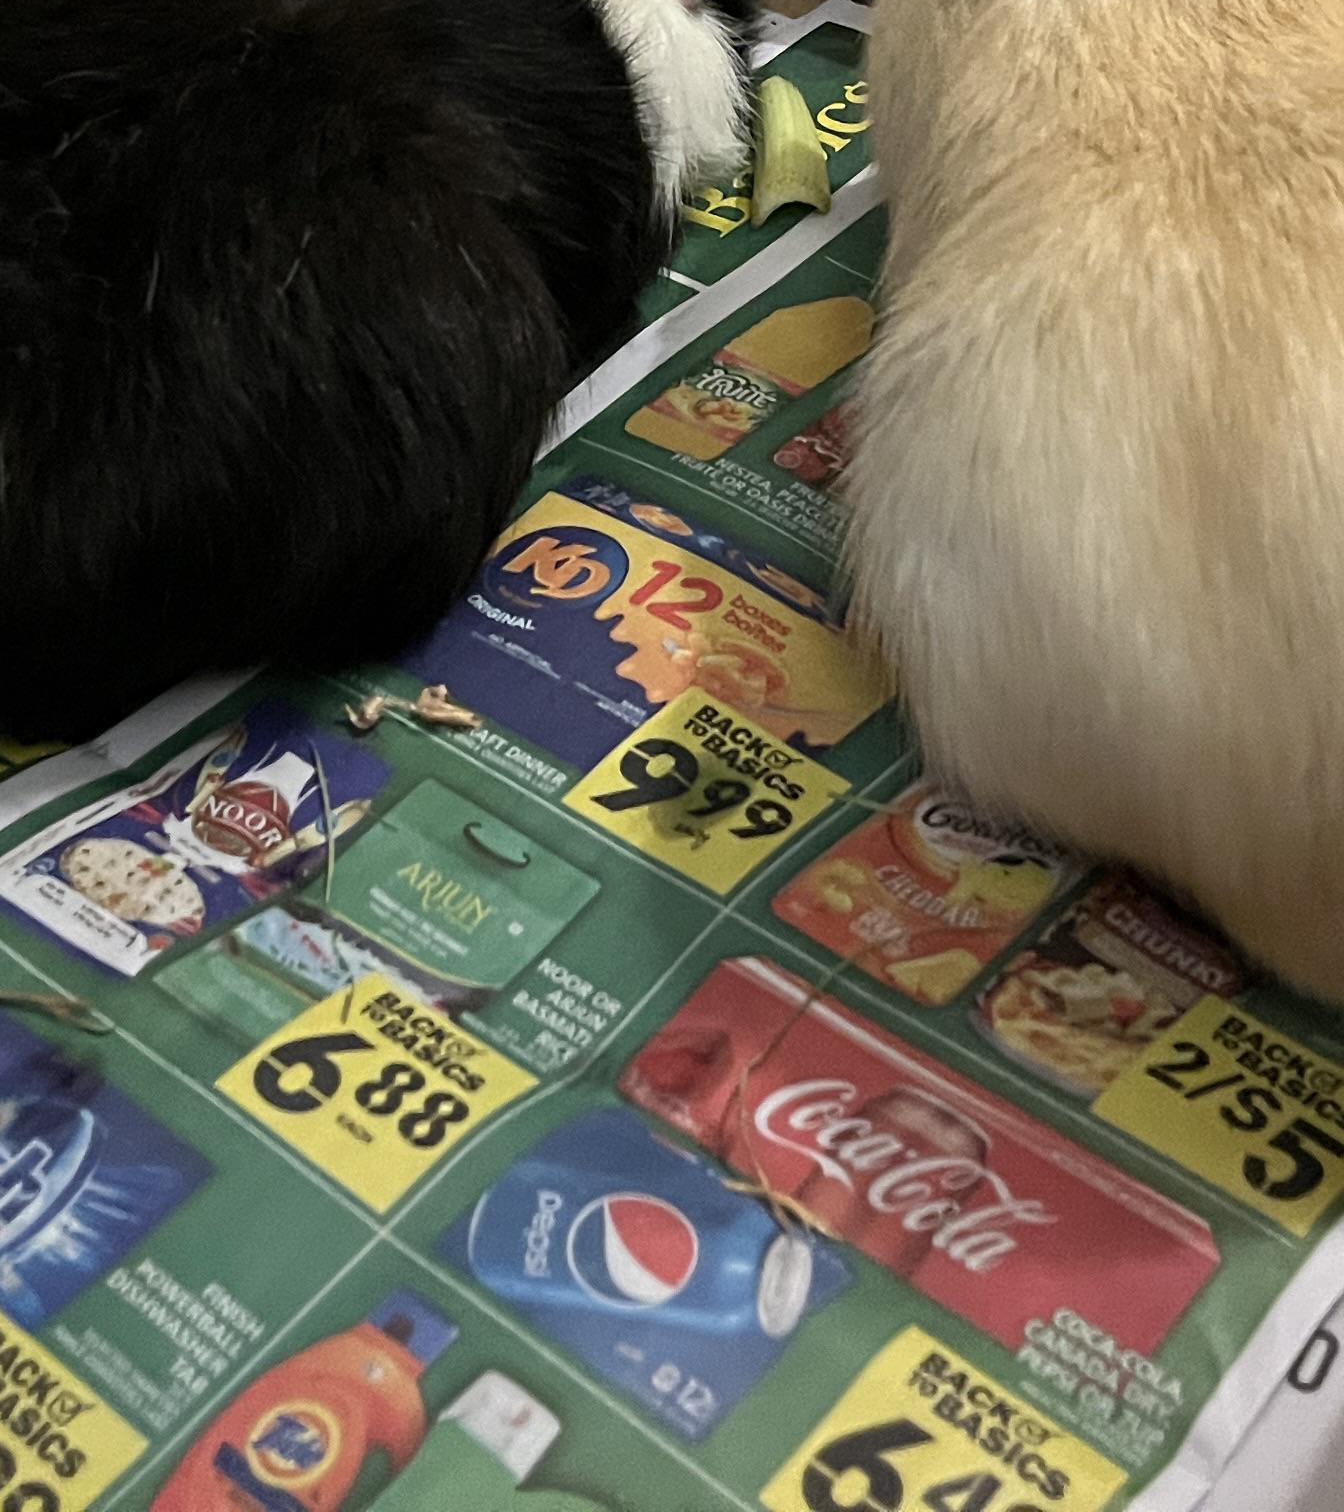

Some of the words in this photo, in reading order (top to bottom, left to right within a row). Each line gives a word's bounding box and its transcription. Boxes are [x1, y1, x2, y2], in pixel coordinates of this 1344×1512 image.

[465, 593, 536, 632] ORIGINAL
[502, 536, 612, 599] KD
[628, 559, 724, 631] 12
[729, 595, 792, 637] boxes
[504, 742, 568, 787] DINNER
[684, 719, 711, 739] TO
[701, 731, 806, 802] BASICS
[692, 703, 770, 764] BACK
[202, 796, 283, 853] NOOR
[398, 859, 493, 934] ARJUN
[873, 863, 984, 929] CHEDDAR
[1103, 902, 1238, 991] CHUNKY
[372, 991, 455, 1051] BACK
[536, 955, 594, 999] NOOR
[589, 988, 622, 1017] OR
[359, 1003, 387, 1026] TO
[379, 1015, 487, 1093] BASICS
[1212, 1030, 1243, 1056] TO
[1219, 1014, 1316, 1077] BACK
[755, 1079, 1054, 1274] Coca-Cola
[134, 1257, 245, 1359] POWERBALL
[1021, 1314, 1125, 1393] CANADA
[918, 1352, 1019, 1428] BACK
[908, 1367, 939, 1399] TO
[932, 1395, 1072, 1502] BASICS
